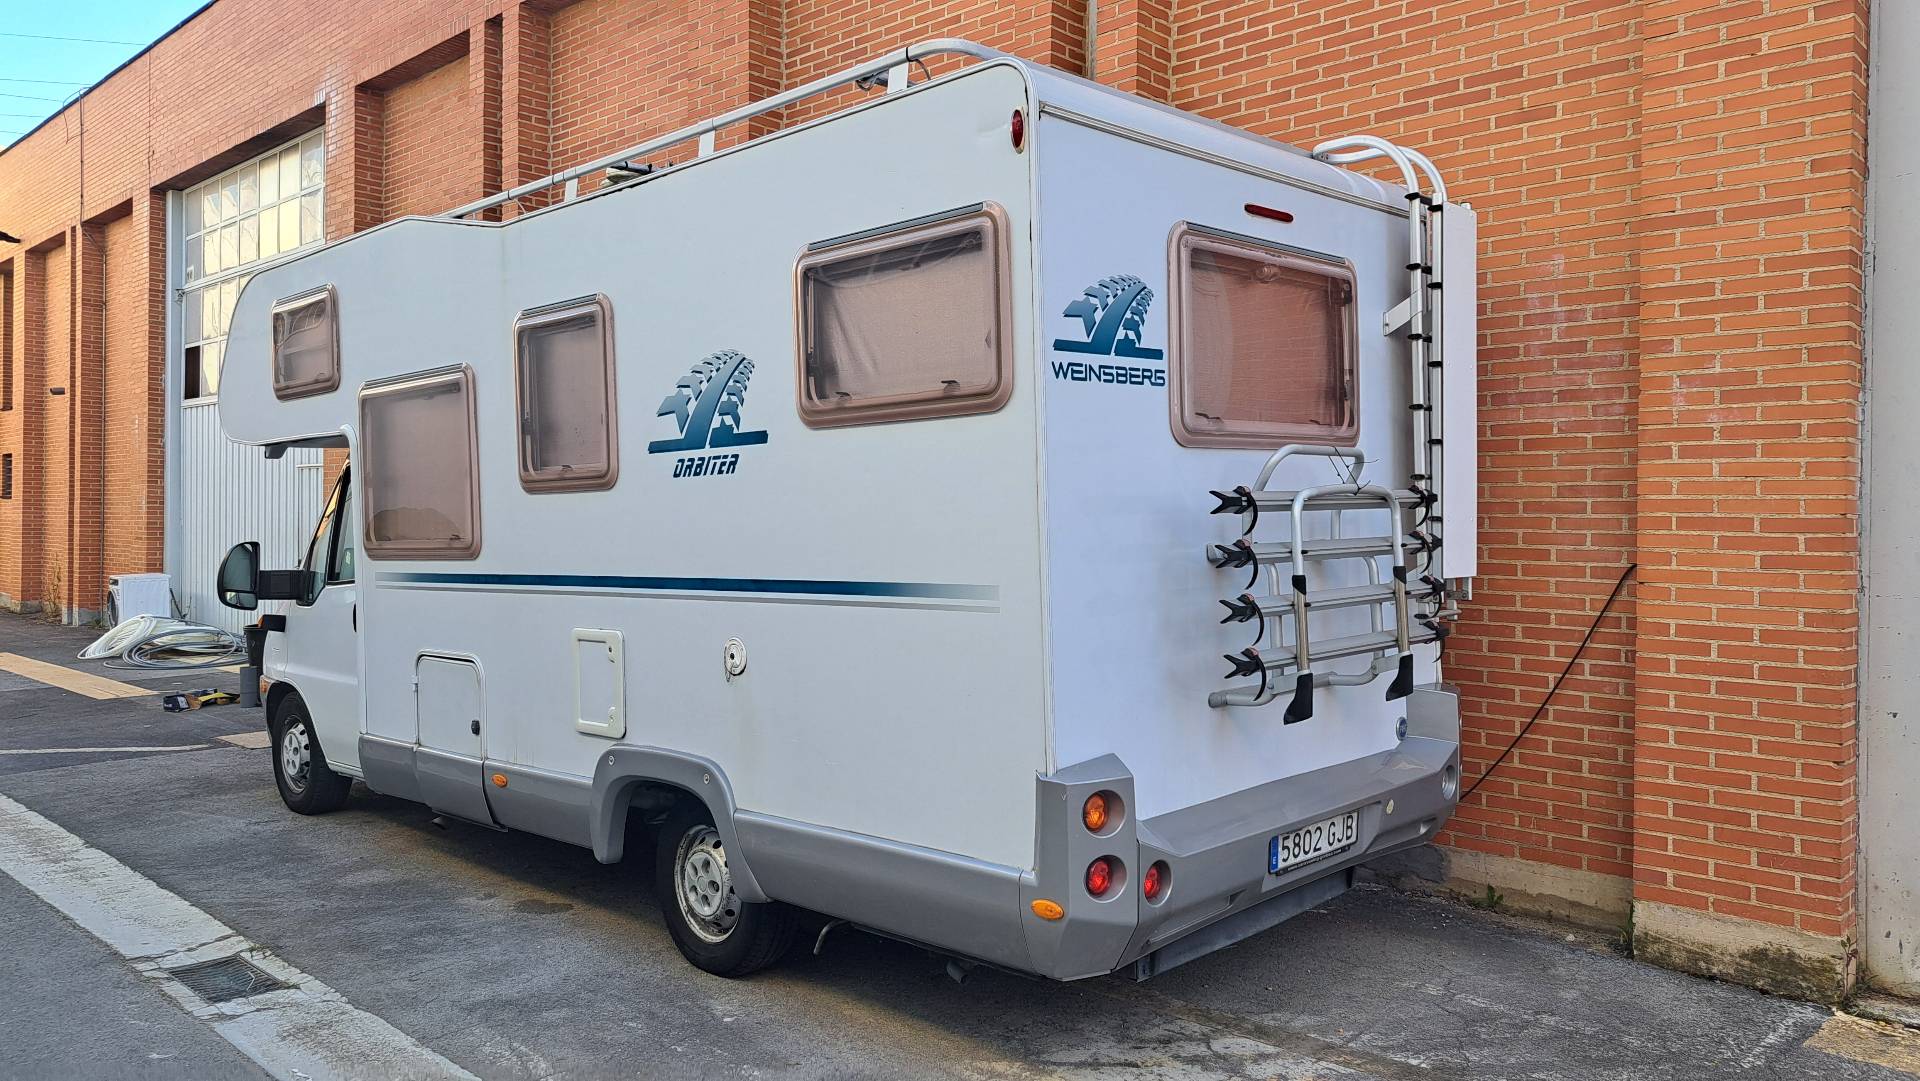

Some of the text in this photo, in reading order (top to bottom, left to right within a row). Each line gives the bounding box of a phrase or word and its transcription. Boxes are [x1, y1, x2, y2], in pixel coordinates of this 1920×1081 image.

[1052, 361, 1165, 386] WEINSBERG
[673, 454, 739, 478] ORBITER
[1282, 826, 1322, 862] 5802
[1327, 815, 1353, 846] GJB
